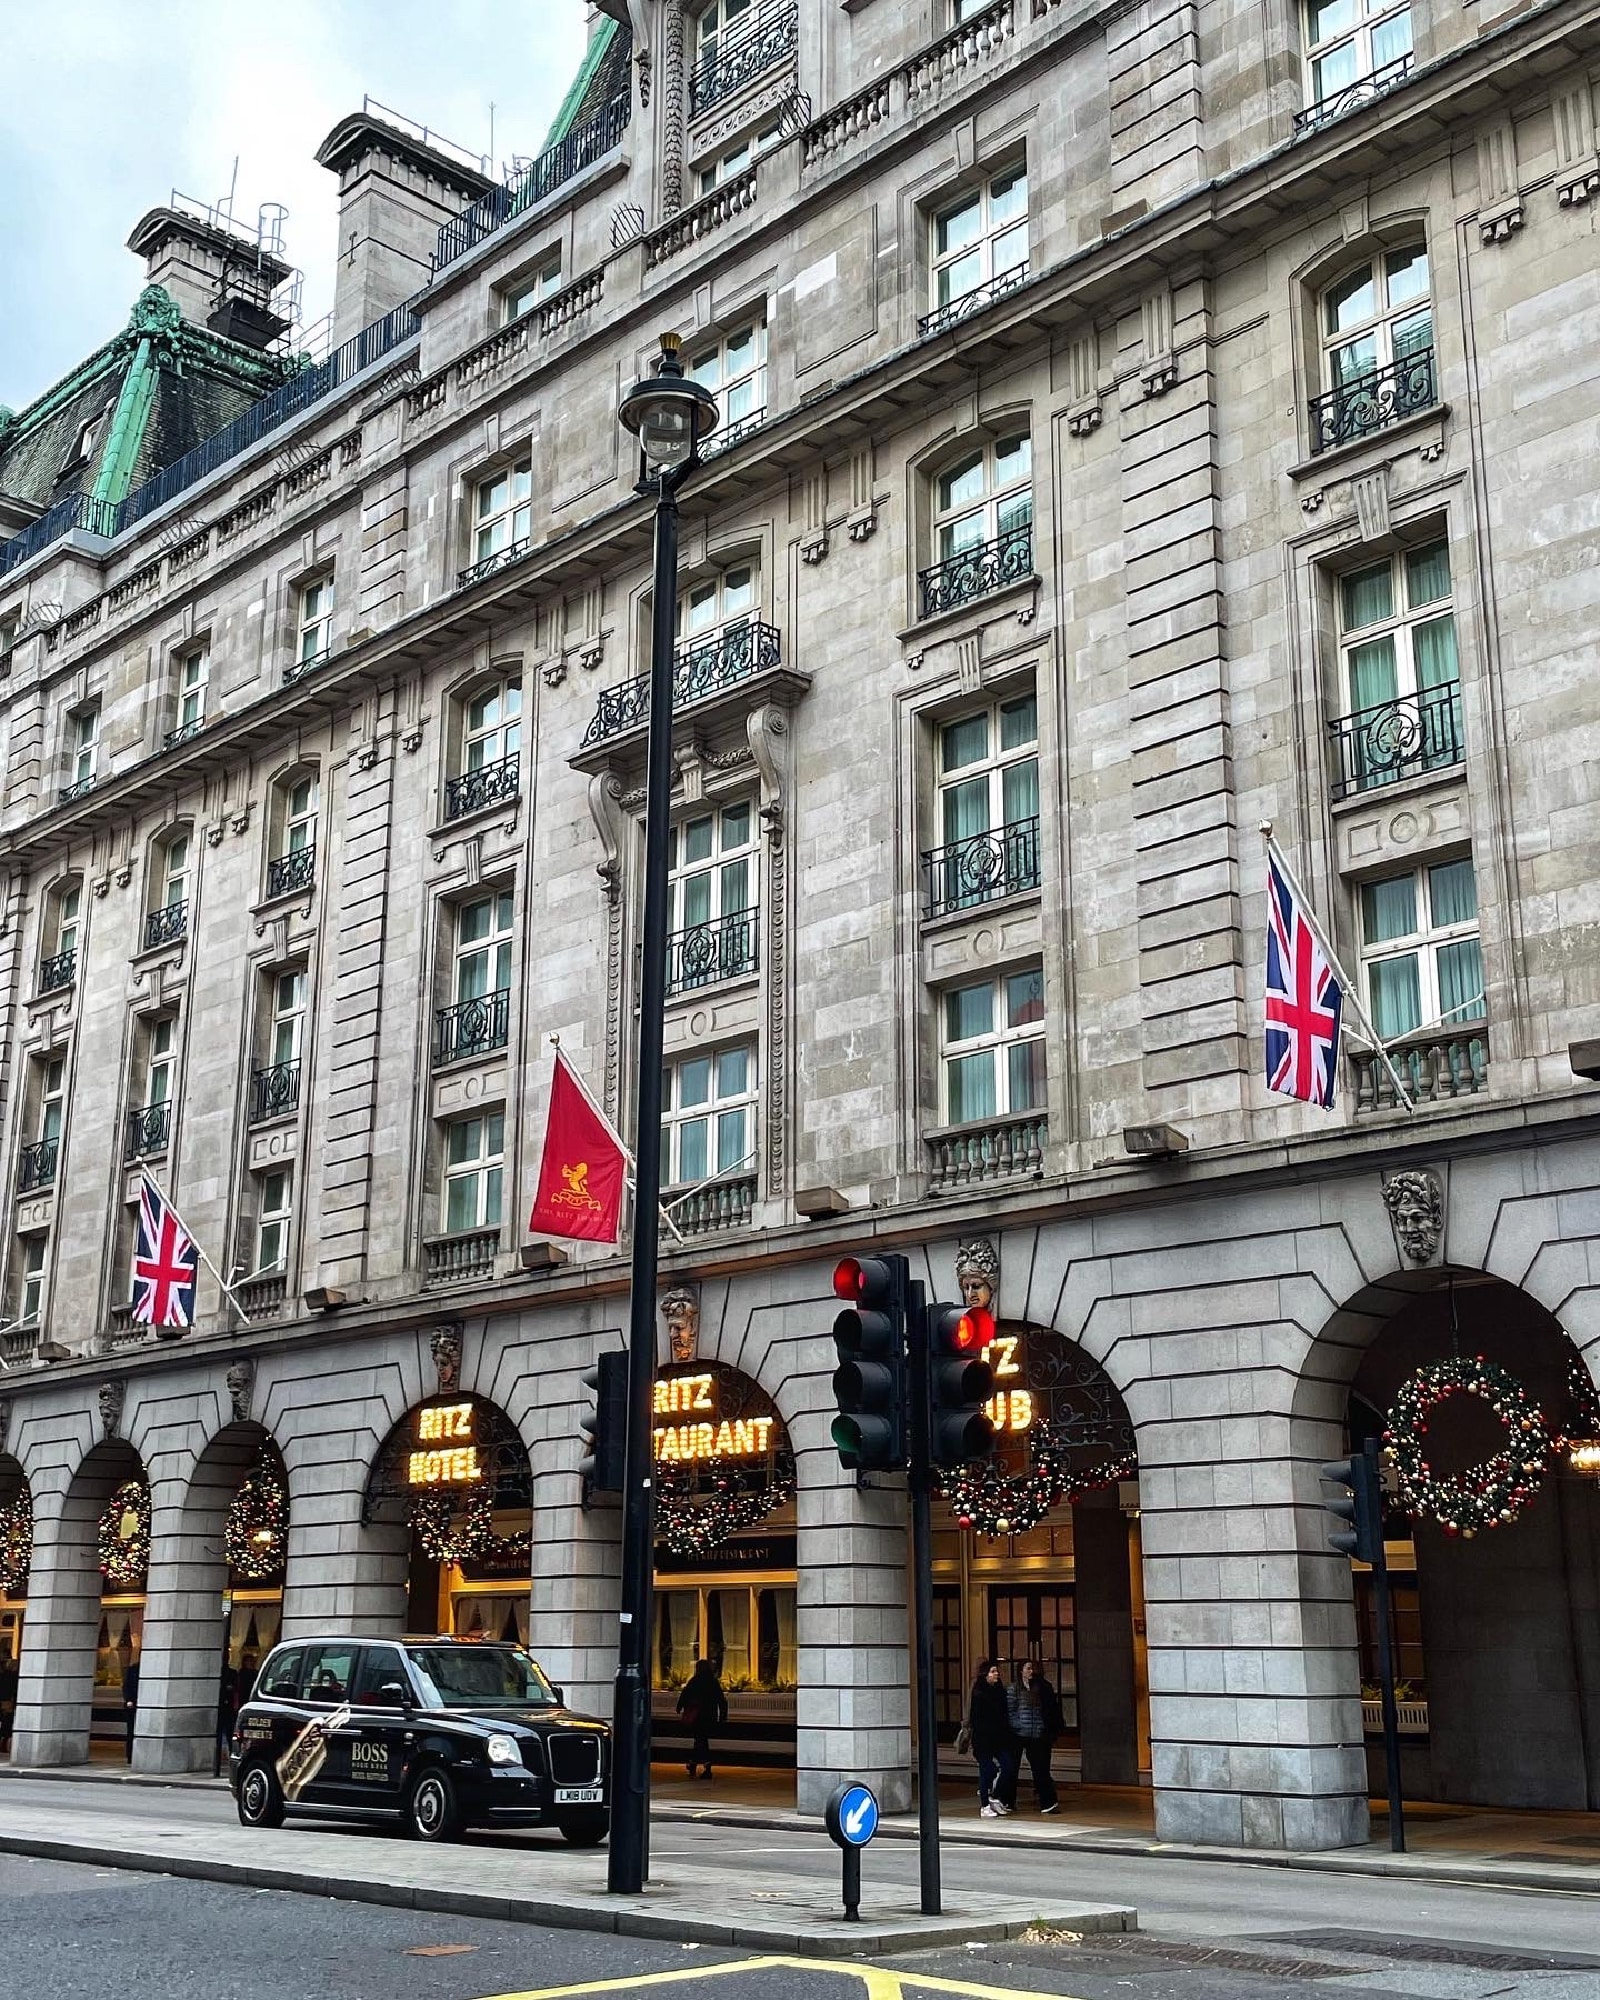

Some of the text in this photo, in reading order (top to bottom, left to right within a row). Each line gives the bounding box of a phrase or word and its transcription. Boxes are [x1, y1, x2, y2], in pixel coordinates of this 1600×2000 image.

[654, 1373, 712, 1413] RITZ
[985, 1390, 1031, 1429] UB
[419, 1403, 473, 1439] RITZ
[654, 1416, 773, 1460] TAURANT
[409, 1446, 481, 1483] HOTEL
[351, 1742, 388, 1762] BOSS
